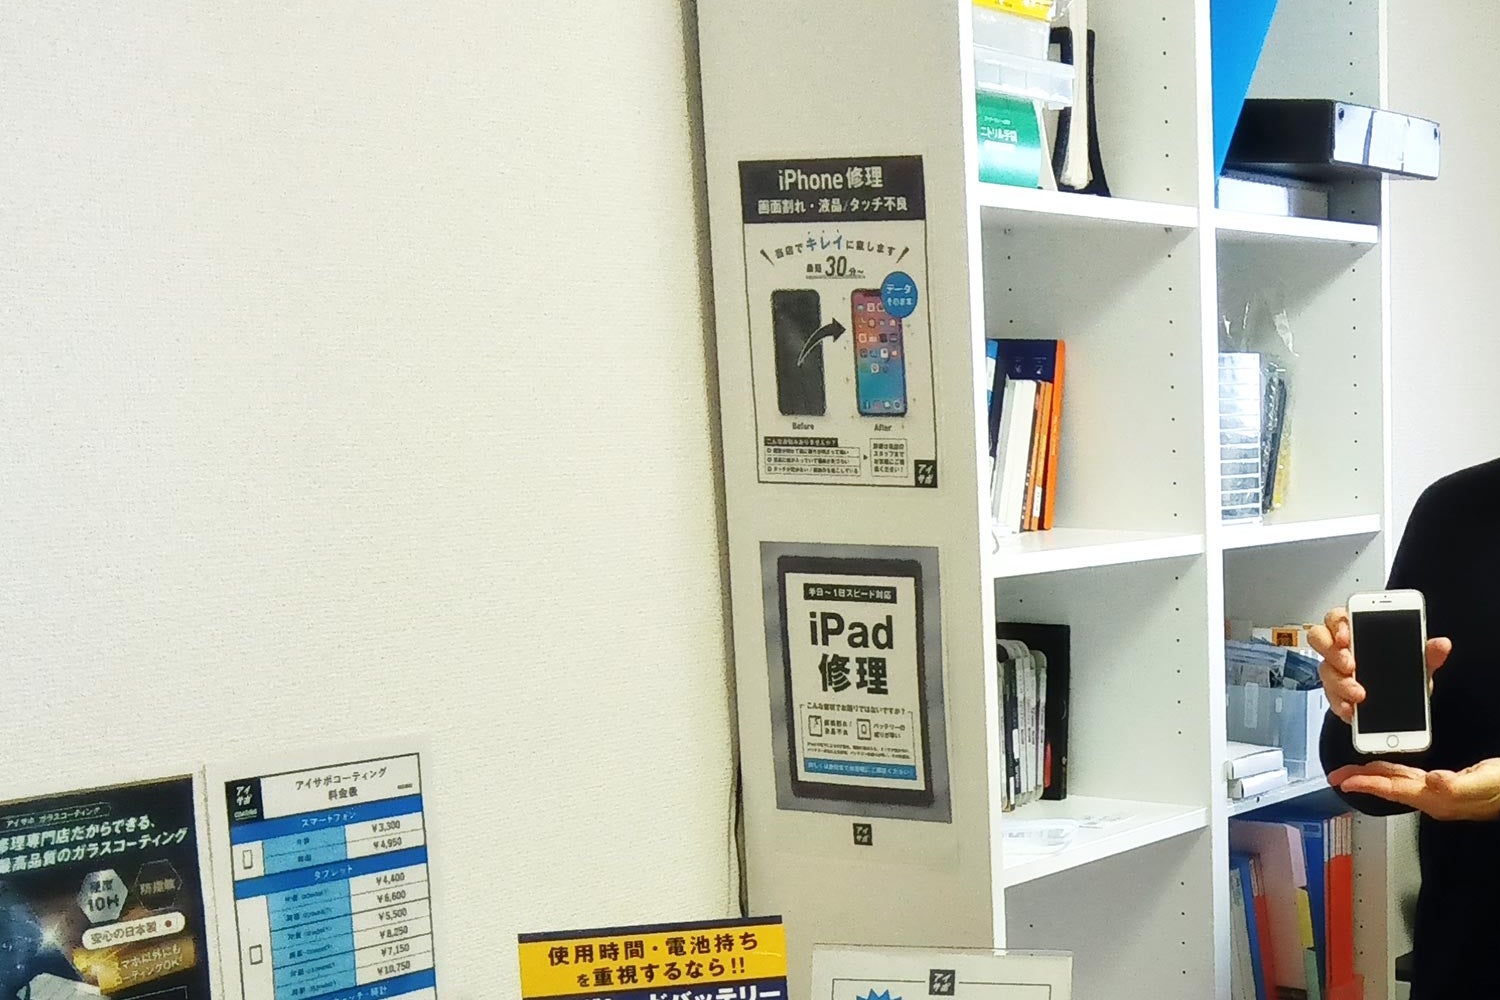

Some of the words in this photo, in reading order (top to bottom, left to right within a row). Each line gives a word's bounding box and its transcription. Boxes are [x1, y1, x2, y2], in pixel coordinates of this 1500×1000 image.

[809, 611, 894, 649] iPad
[818, 653, 888, 695] 修理
[548, 932, 758, 967] 使用時間・電池持ち
